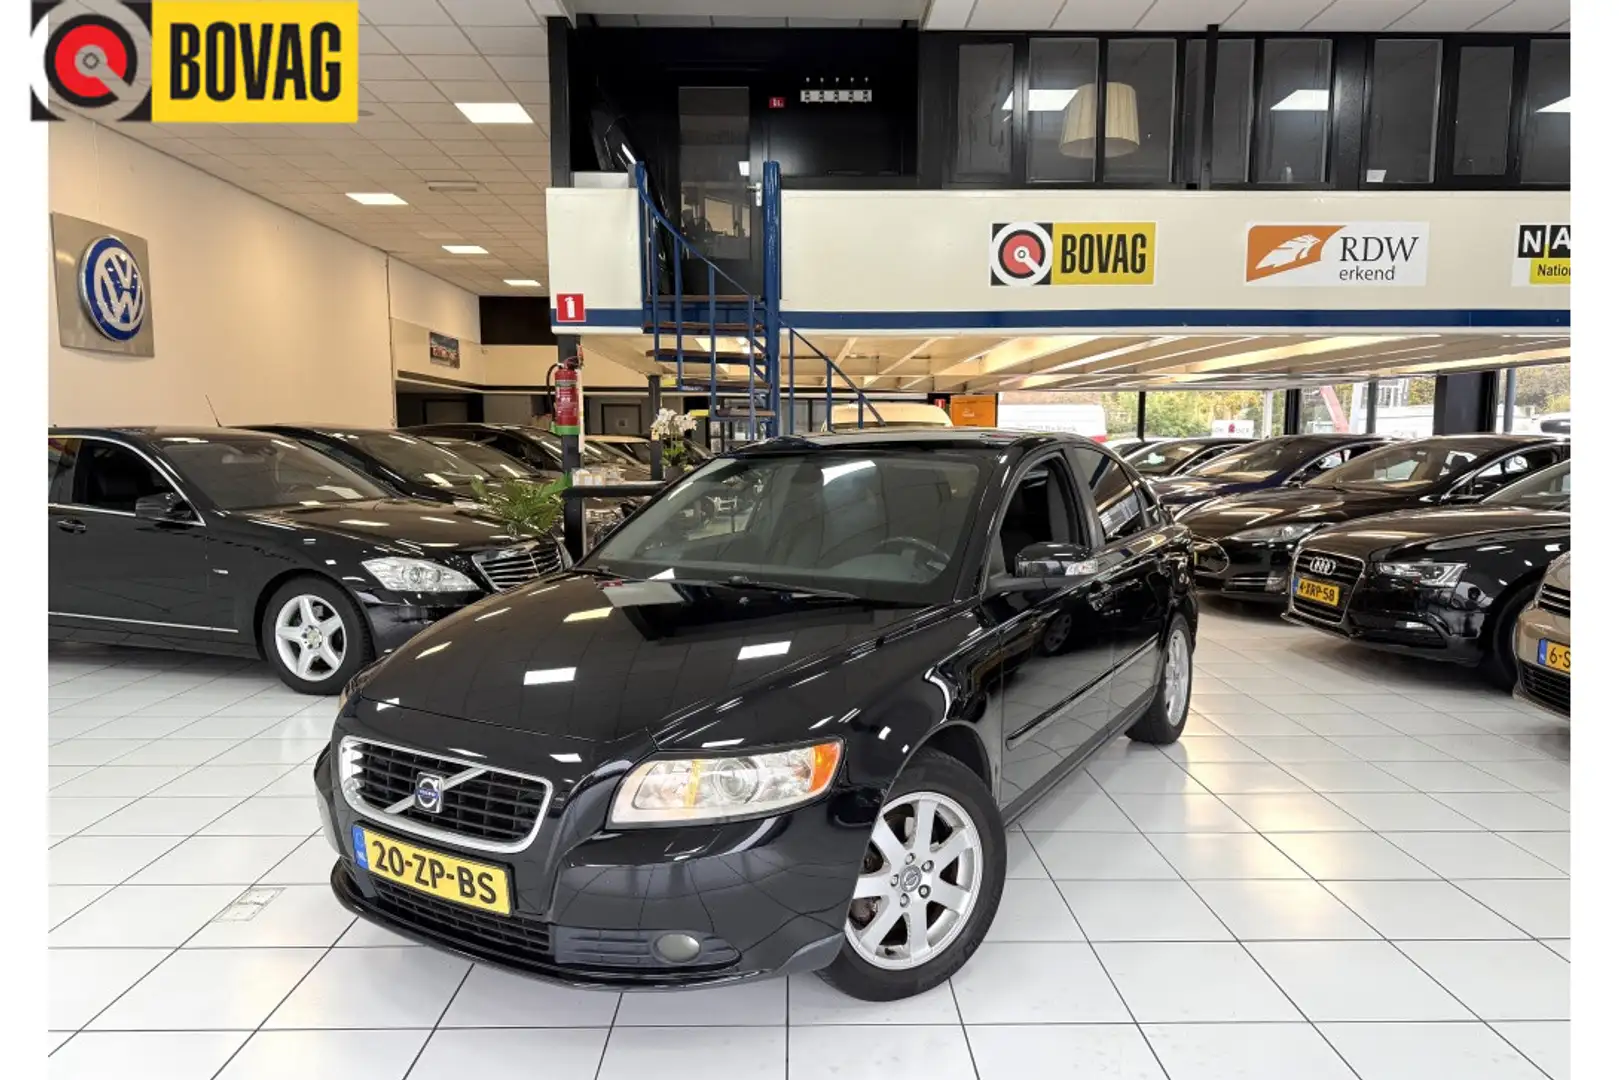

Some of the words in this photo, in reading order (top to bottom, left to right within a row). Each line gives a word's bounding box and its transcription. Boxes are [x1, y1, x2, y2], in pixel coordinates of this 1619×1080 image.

[1339, 236, 1419, 262] RDW
[1523, 227, 1570, 253] NA
[1060, 233, 1147, 274] BOVAG
[1339, 265, 1395, 281] erkend
[372, 840, 497, 904] 20-ZP-BS
